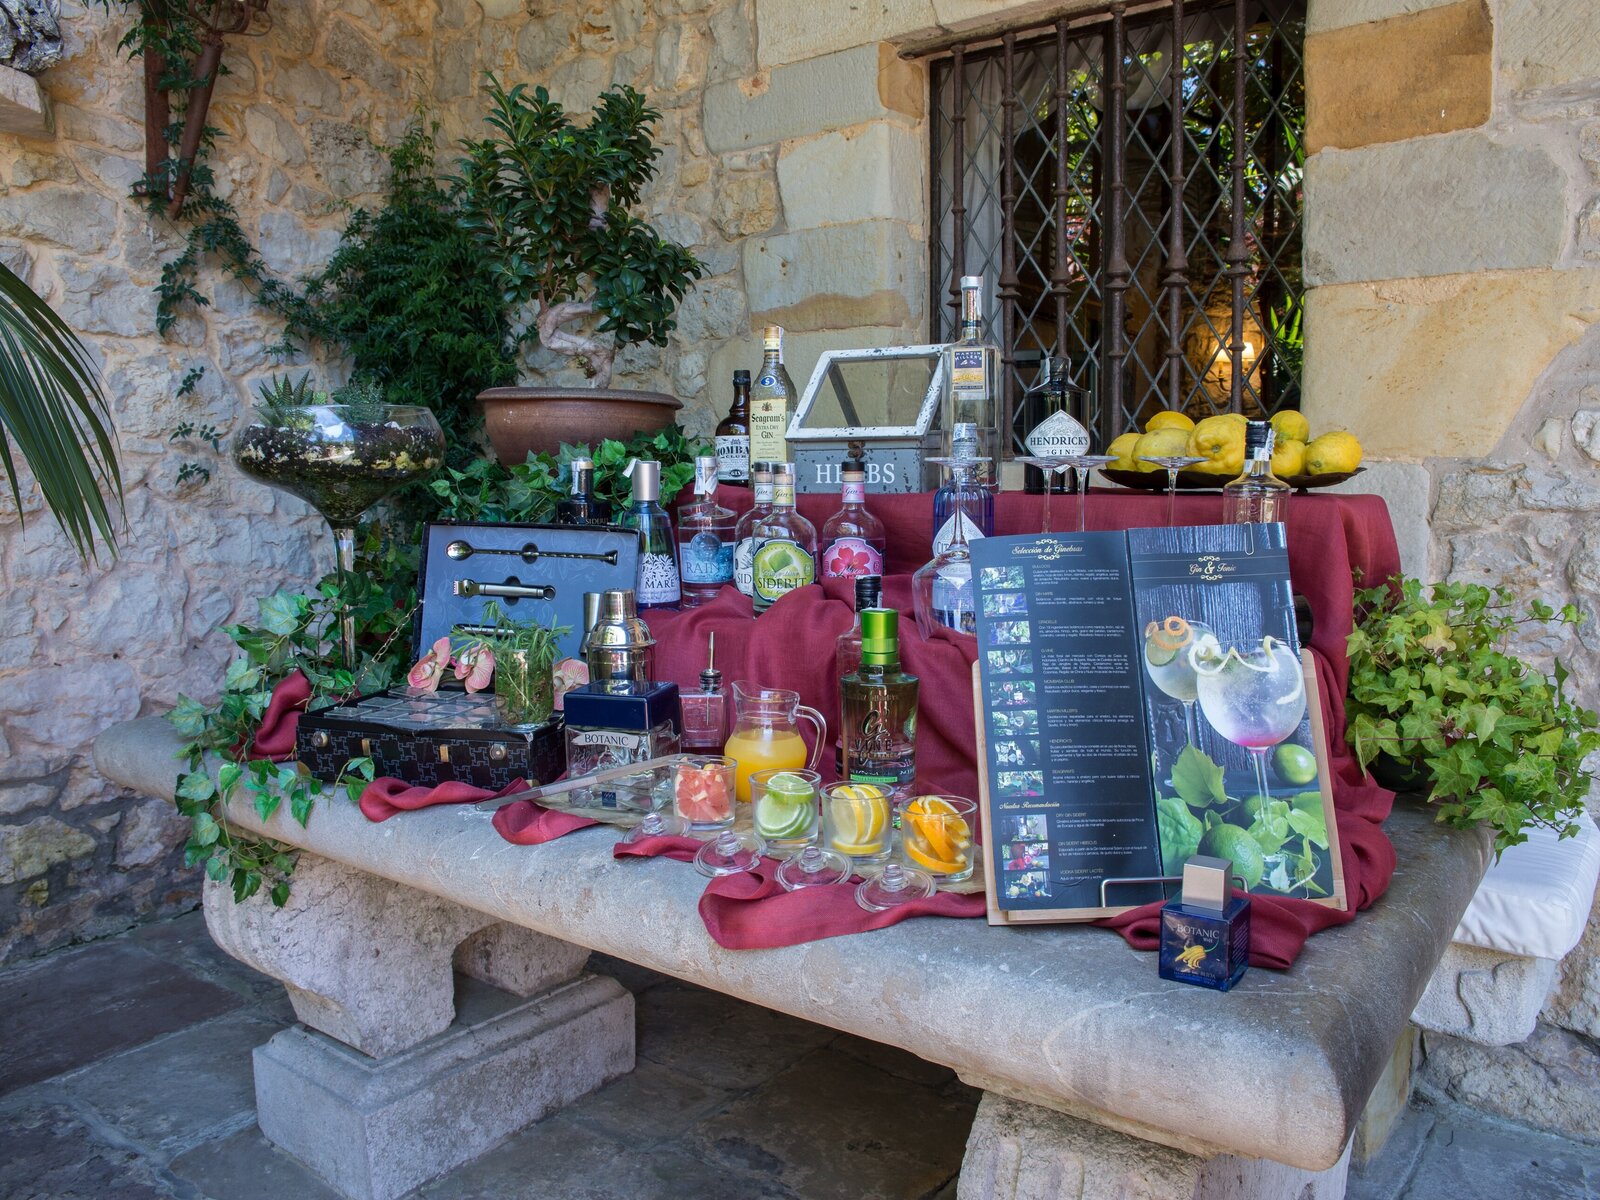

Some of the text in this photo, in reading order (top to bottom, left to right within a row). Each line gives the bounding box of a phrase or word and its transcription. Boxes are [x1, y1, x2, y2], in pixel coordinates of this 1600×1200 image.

[752, 413, 785, 425] Seagram's
[815, 463, 895, 484] HEBS
[755, 487, 768, 497] Gin
[775, 489, 788, 500] Gin
[845, 486, 858, 497] Gin
[1012, 543, 1083, 555] Selección de Ginebras
[1189, 561, 1237, 575] Gin & Tonic
[645, 579, 675, 588] MARE
[757, 577, 807, 589] SIDERIT
[584, 734, 629, 746] BOTANIC
[1177, 924, 1220, 939] BOTANIC
